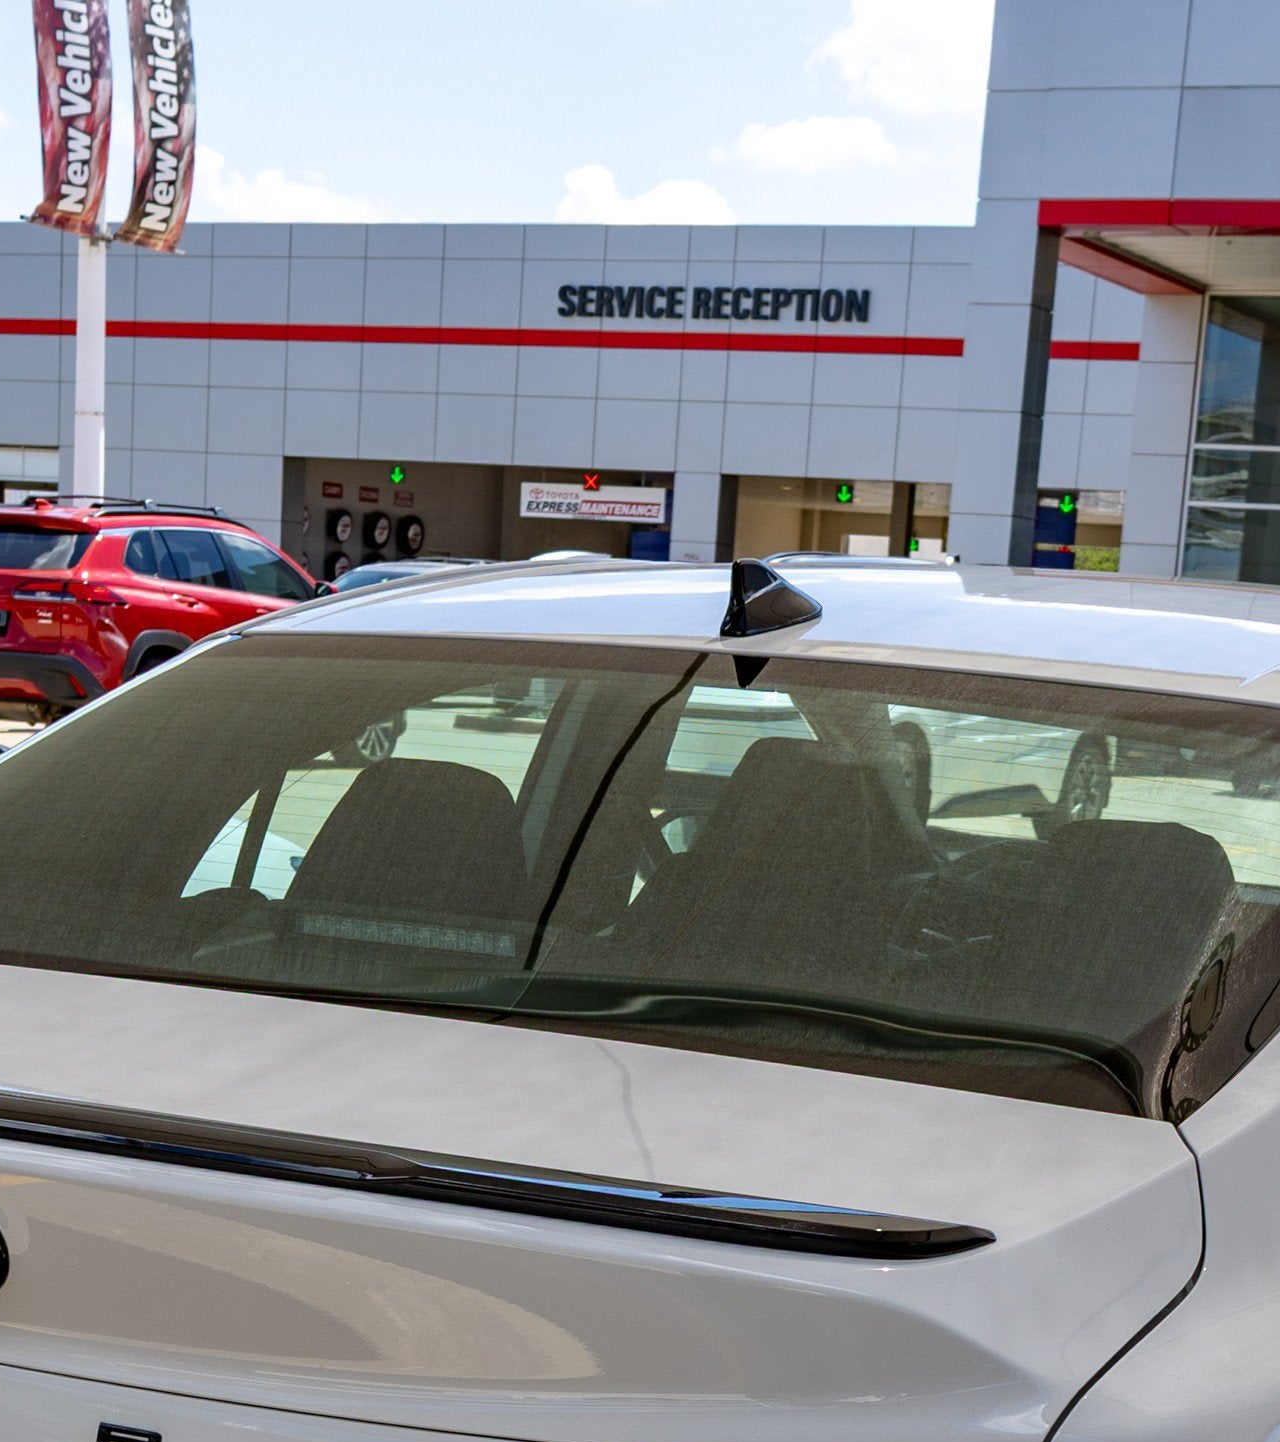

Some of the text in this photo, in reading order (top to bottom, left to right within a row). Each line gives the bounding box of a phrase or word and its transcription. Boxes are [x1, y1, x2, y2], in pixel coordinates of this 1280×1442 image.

[56, 126, 92, 213] New
[140, 150, 179, 231] New
[557, 285, 870, 323] SERVICE RECEPTION
[526, 500, 579, 513] EXPRESS
[580, 503, 660, 517] MAINTENANCE
[545, 491, 580, 500] TOYOTA
